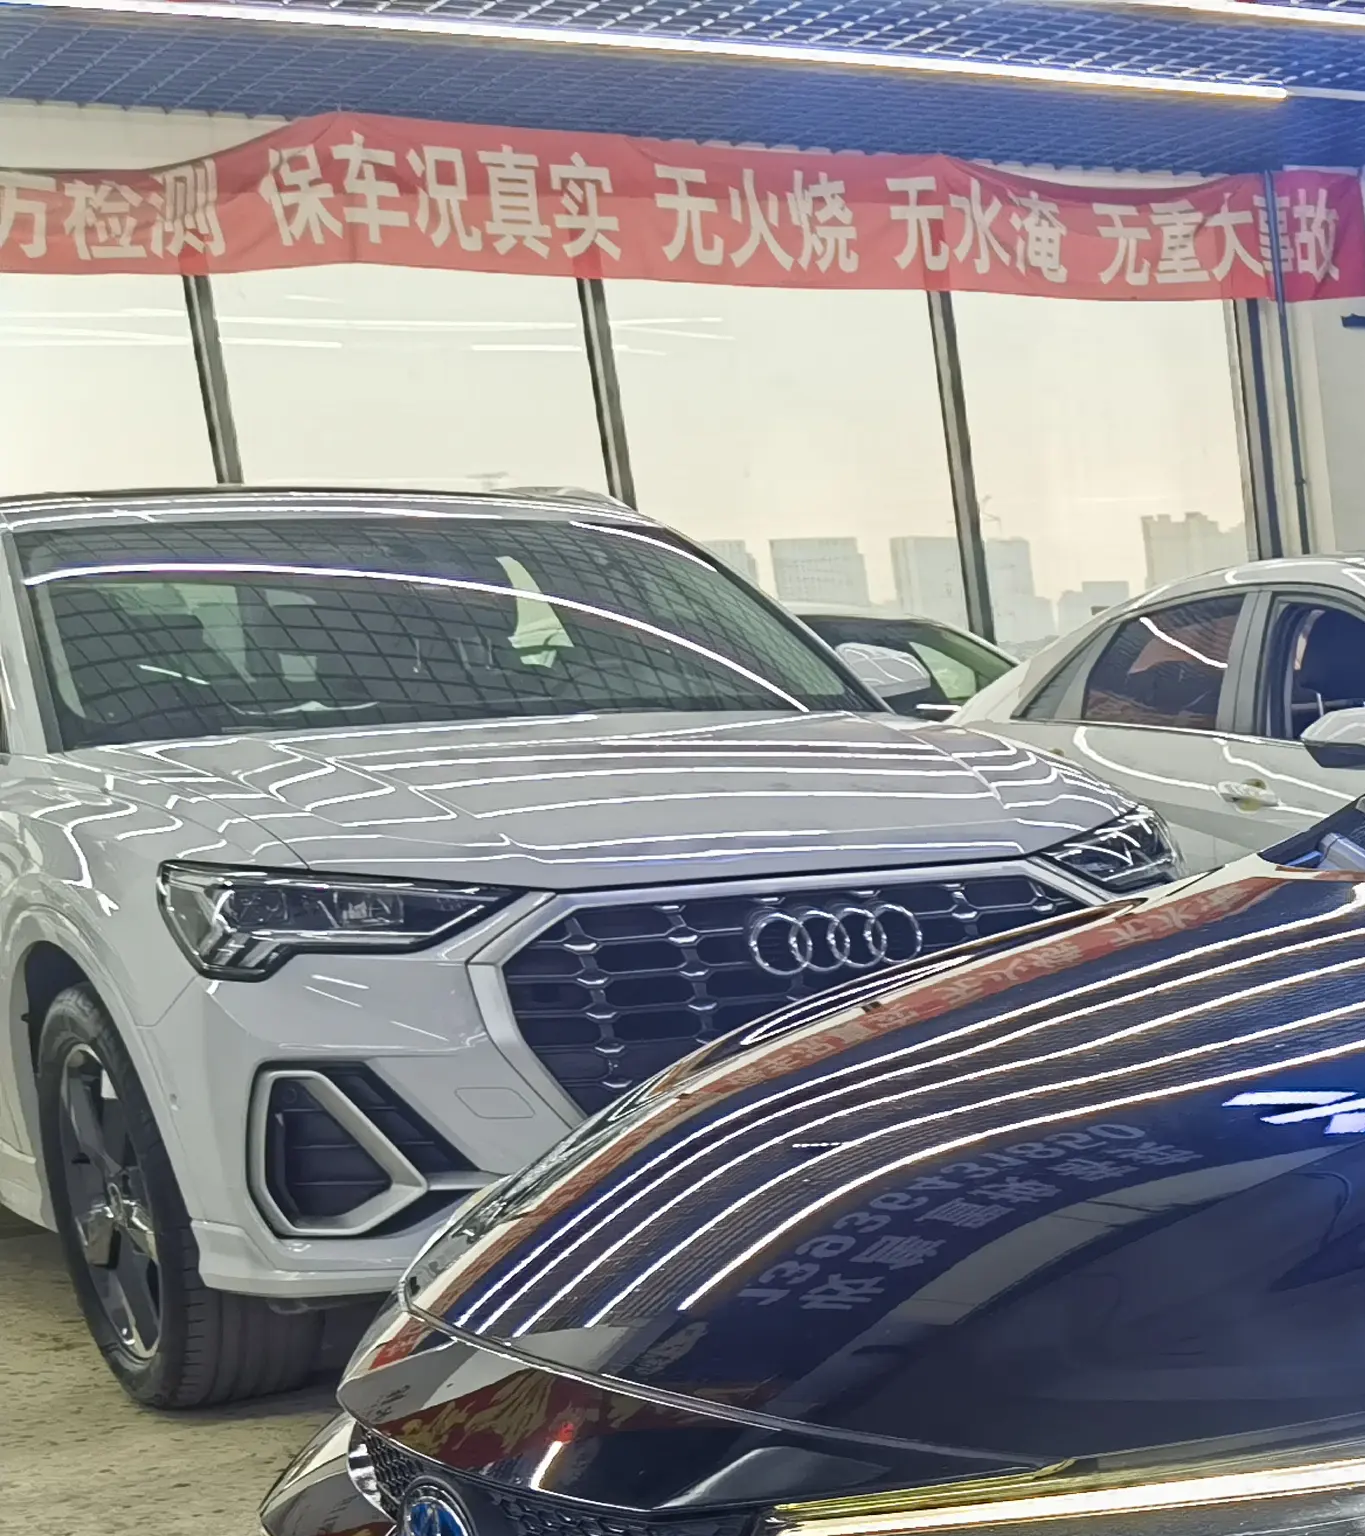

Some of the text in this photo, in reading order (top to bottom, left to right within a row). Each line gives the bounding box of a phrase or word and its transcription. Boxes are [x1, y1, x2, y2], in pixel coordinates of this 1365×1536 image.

[261, 131, 621, 260] 保车况真实
[654, 164, 859, 272] 无火烧
[886, 176, 1068, 285] 无水淹
[1092, 188, 1339, 286] 无重大事故
